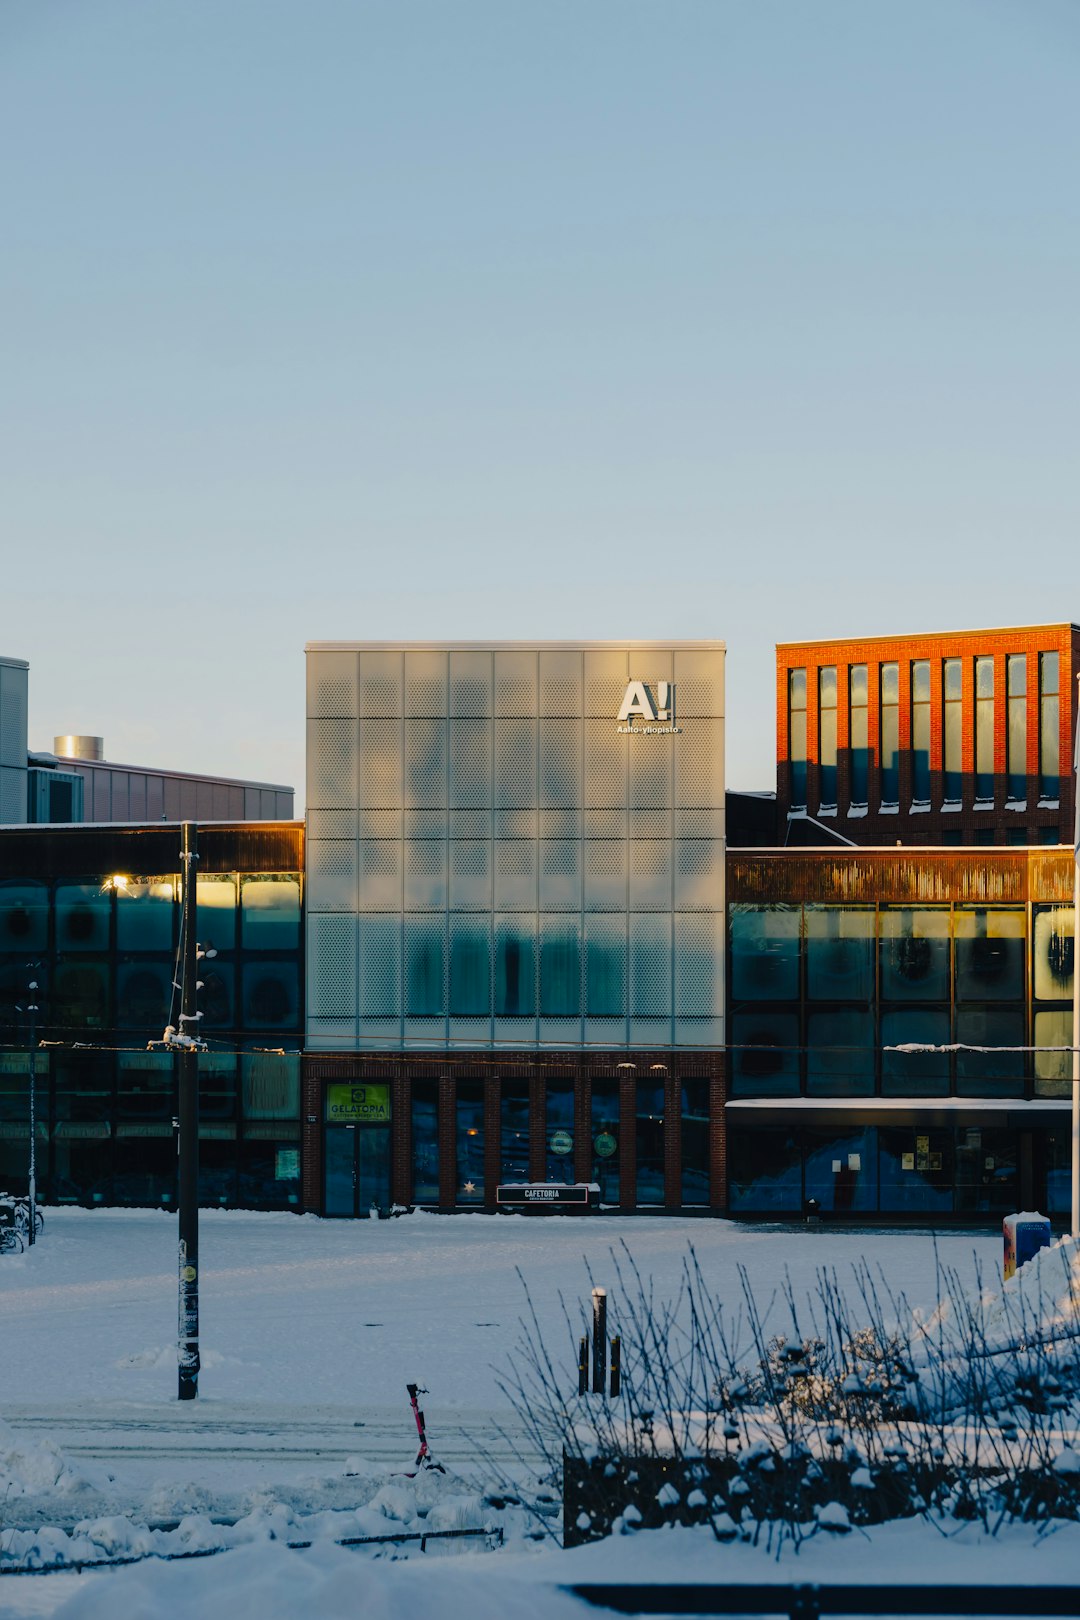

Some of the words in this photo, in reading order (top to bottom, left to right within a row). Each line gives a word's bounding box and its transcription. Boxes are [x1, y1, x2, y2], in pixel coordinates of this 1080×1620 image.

[617, 681, 668, 720] A!
[617, 726, 679, 735] Aalto-yliopisto
[331, 1104, 385, 1113] GELATORIA
[524, 1189, 560, 1198] CAFETORIA
